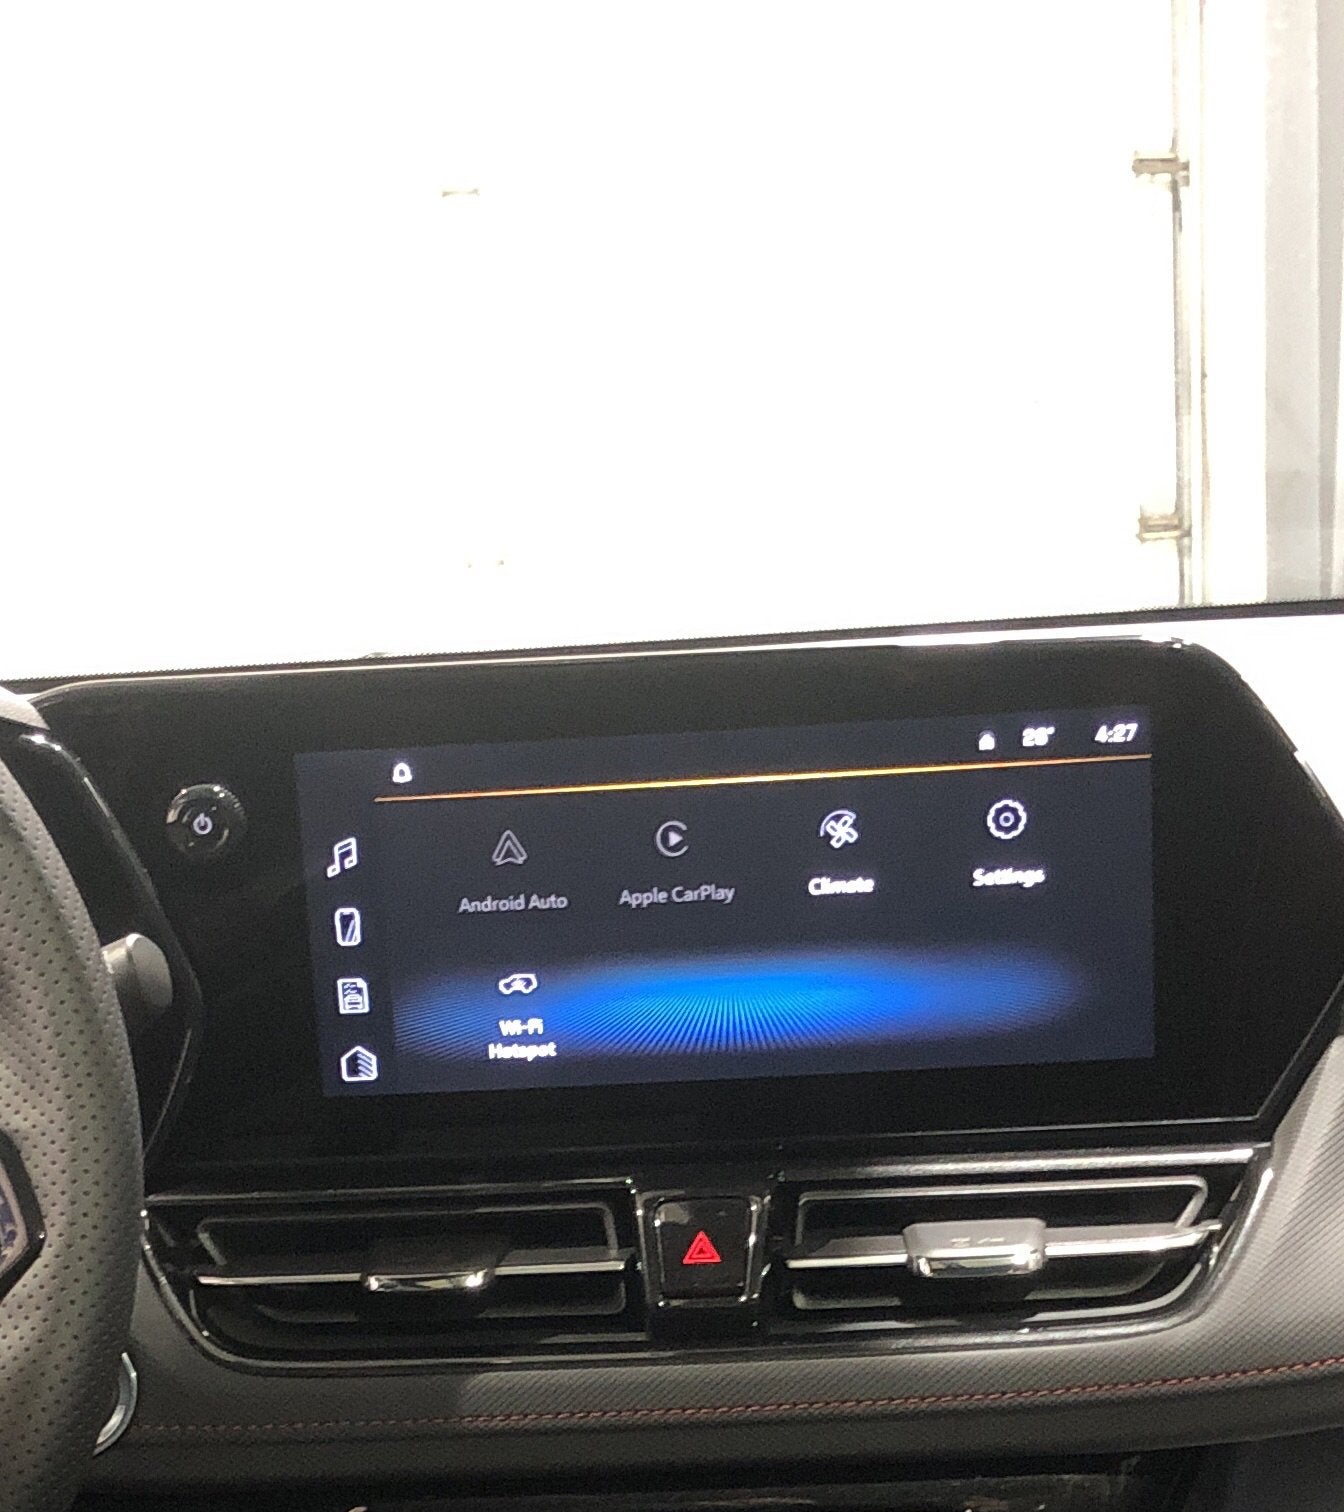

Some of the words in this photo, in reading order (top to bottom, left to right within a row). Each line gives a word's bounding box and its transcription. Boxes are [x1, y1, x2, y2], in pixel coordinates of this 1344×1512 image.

[1094, 723, 1139, 743] 4:27
[808, 876, 874, 895] Climate
[973, 868, 1045, 888] Settings
[458, 894, 526, 913] Android
[528, 894, 568, 910] Auto
[619, 887, 668, 908] Apple
[671, 884, 735, 905] CarPlay
[499, 1017, 544, 1036] Wi-Fi
[488, 1041, 557, 1062] Hotspot
